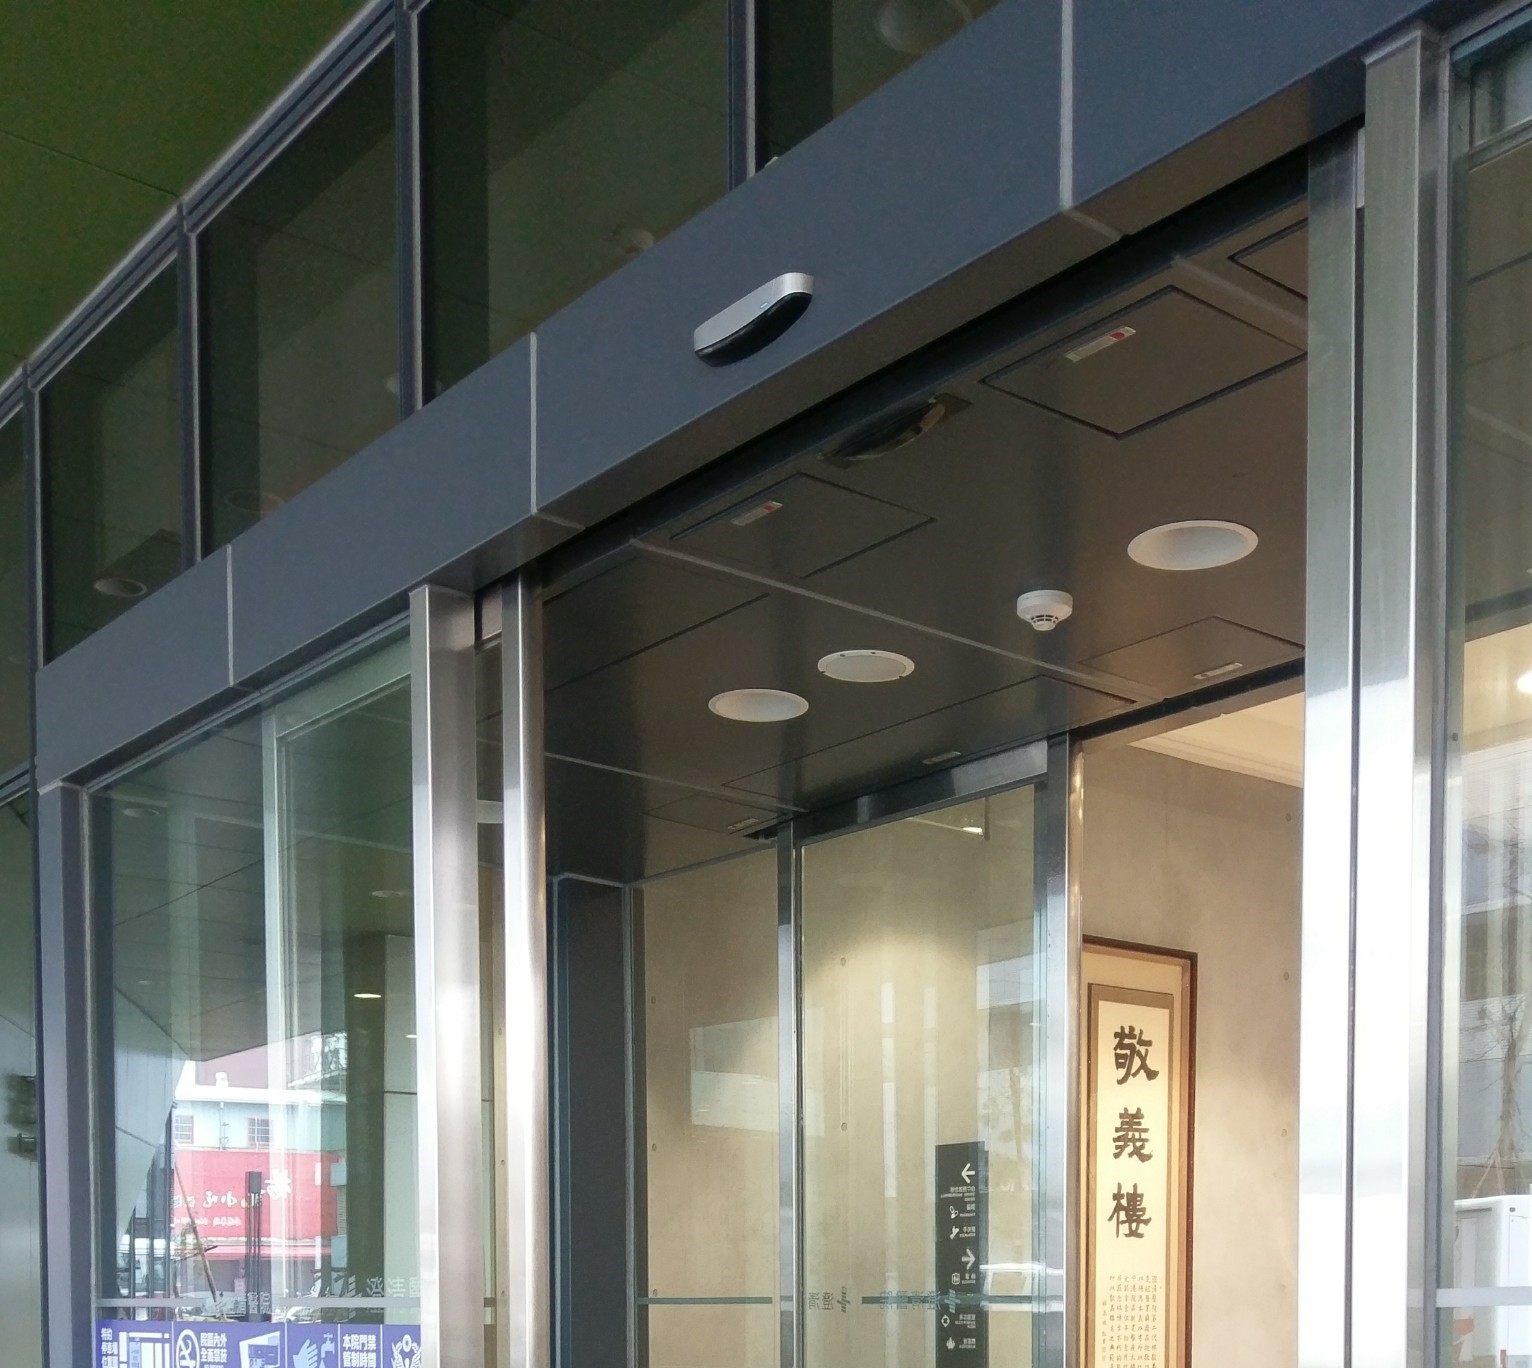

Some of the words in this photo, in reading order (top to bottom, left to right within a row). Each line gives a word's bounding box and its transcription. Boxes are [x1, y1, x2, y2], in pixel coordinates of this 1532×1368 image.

[1107, 1025, 1159, 1239] 敬義樓
[342, 1334, 376, 1350] 本院門禁
[342, 1351, 376, 1368] 管制時間
